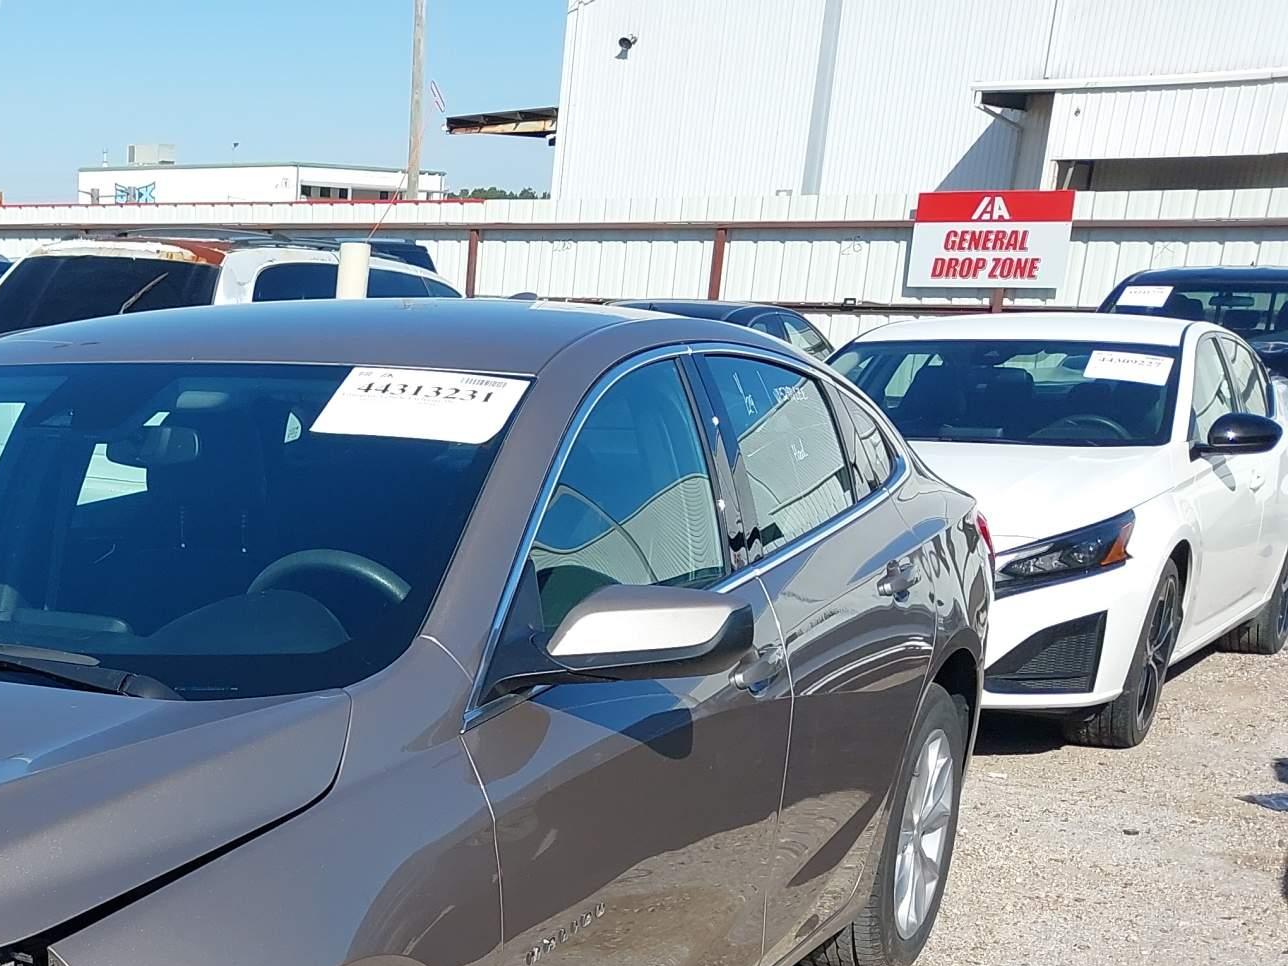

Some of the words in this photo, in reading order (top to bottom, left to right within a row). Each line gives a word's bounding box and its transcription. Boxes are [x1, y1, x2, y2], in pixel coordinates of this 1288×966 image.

[943, 230, 1029, 251] GENERAL
[930, 257, 987, 279] DROP
[987, 257, 1041, 279] ZONE
[357, 382, 494, 403] 44313231
